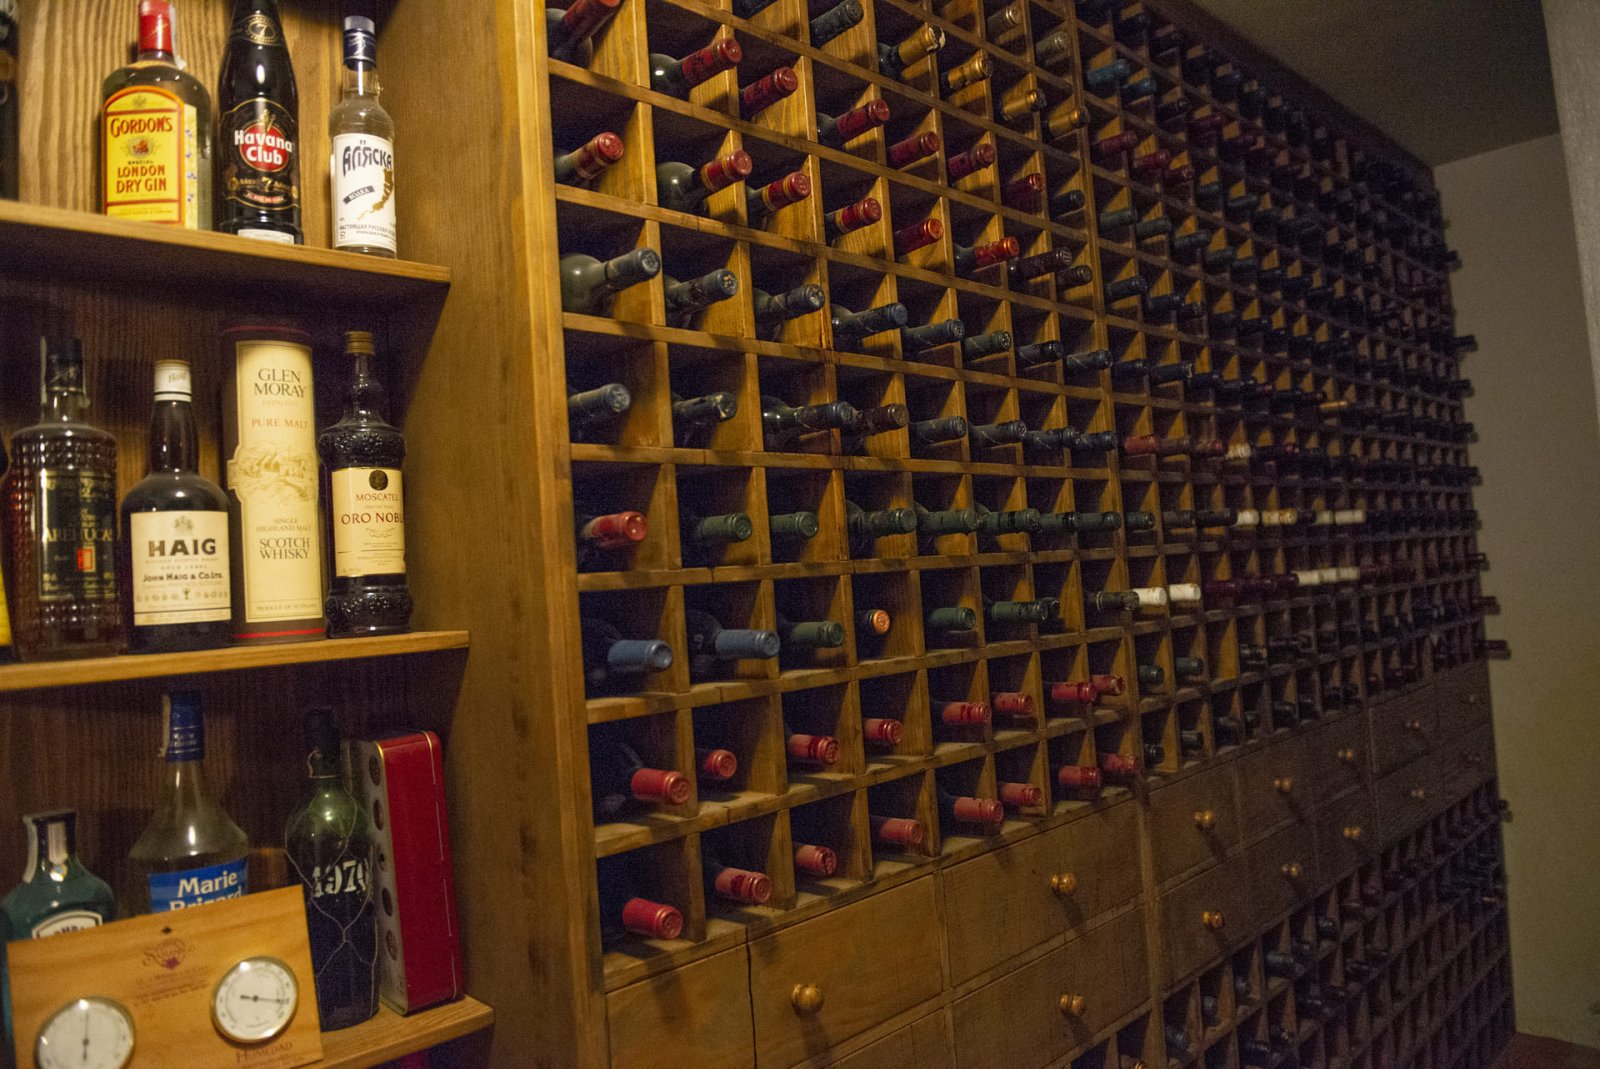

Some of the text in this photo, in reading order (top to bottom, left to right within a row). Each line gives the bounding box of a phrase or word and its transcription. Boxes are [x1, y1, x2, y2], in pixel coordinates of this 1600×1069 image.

[234, 129, 293, 153] Havana
[246, 145, 283, 165] Club
[117, 165, 166, 178] LONDON
[116, 178, 167, 194] DRY GIN
[261, 177, 272, 192] 7
[258, 368, 301, 383] GLEN
[253, 382, 307, 399] MORAY
[251, 418, 309, 429] PURE MALT
[356, 493, 400, 501] MOSCATEL
[341, 512, 371, 525] ORO
[148, 538, 216, 557] HAIG
[259, 537, 310, 549] SCOTCH
[259, 548, 310, 560] WHISKY
[177, 870, 238, 898] Marie
